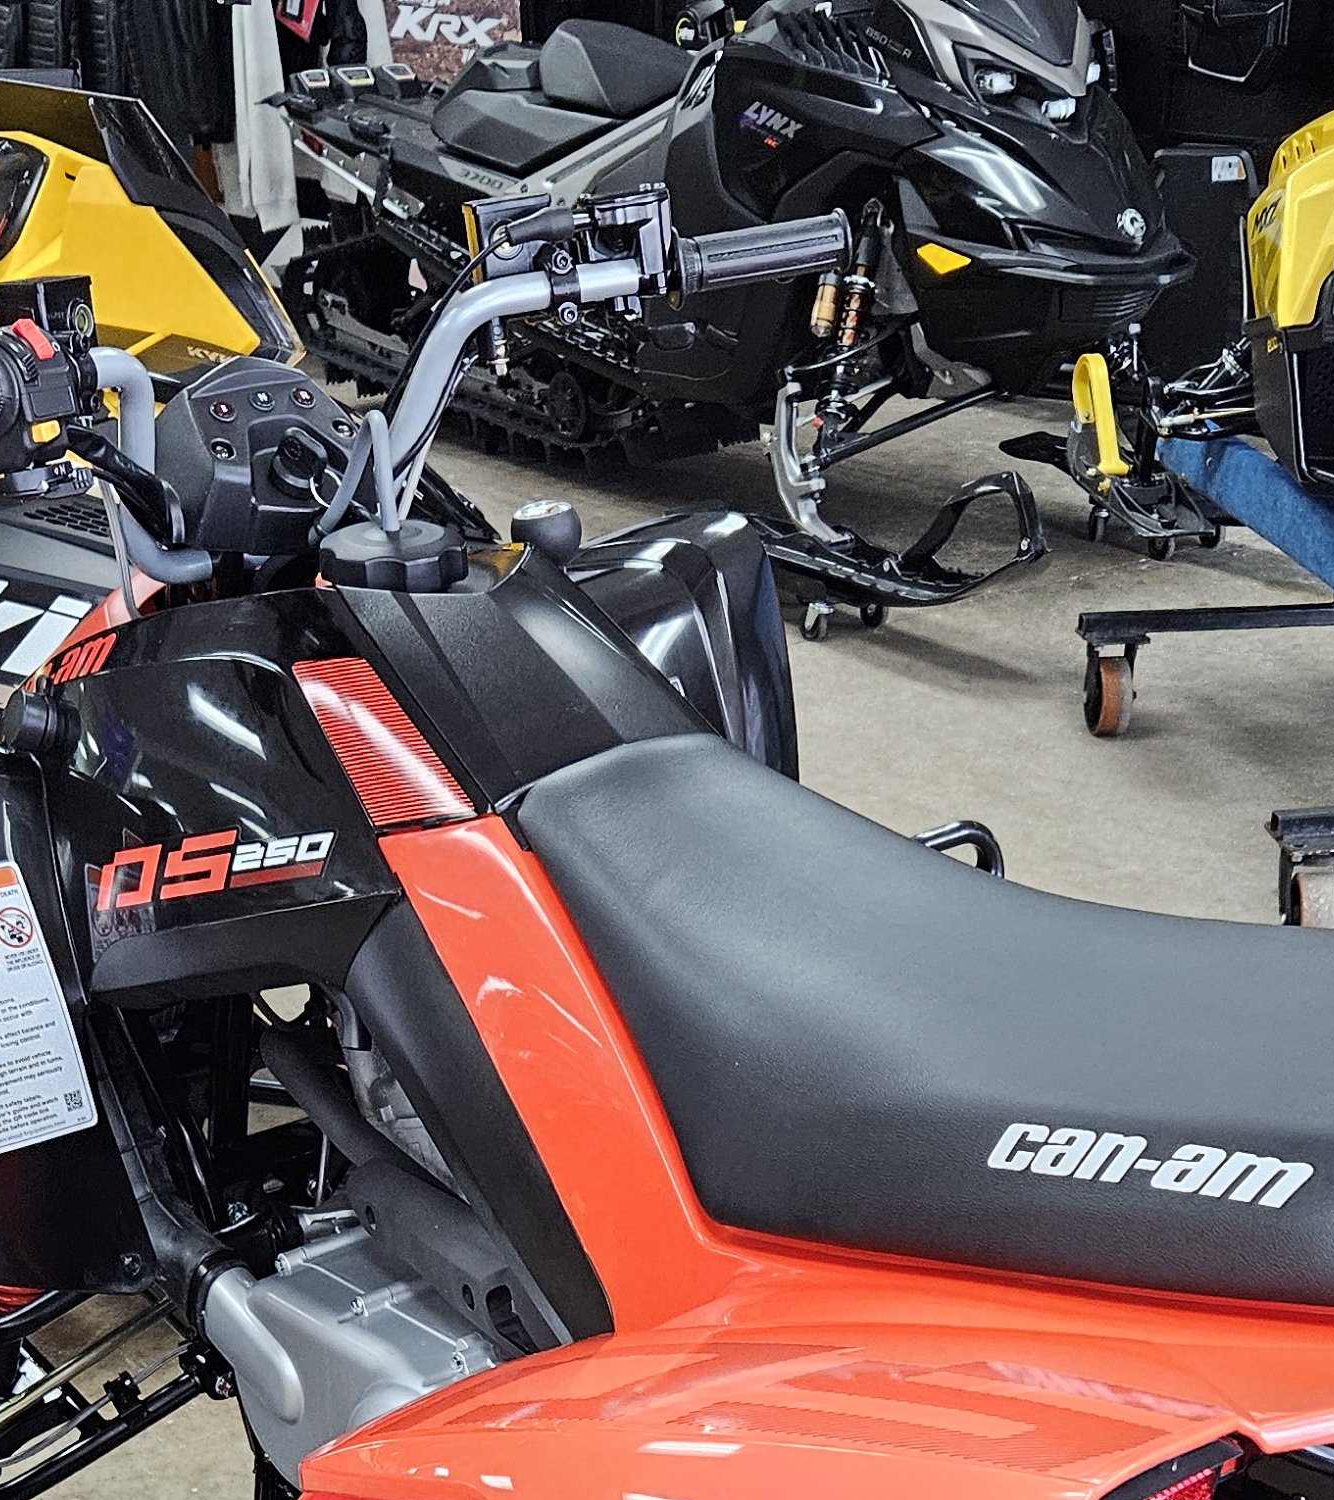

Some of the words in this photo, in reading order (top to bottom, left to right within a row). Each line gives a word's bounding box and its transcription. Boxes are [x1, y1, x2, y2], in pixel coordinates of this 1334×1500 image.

[390, 5, 503, 47] KRX
[742, 101, 804, 140] LYNX
[21, 1024, 43, 1033] balance
[0, 1039, 19, 1049] losing
[14, 1055, 30, 1064] avoid
[31, 1050, 51, 1059] vehicle
[8, 1065, 27, 1074] terrain
[23, 1073, 36, 1081] may
[36, 1065, 63, 1077] seriously
[4, 1099, 22, 1108] safety
[12, 1105, 28, 1114] guide
[41, 1096, 58, 1105] watch
[9, 1121, 28, 1130] before
[986, 1122, 1315, 1209] can-am
